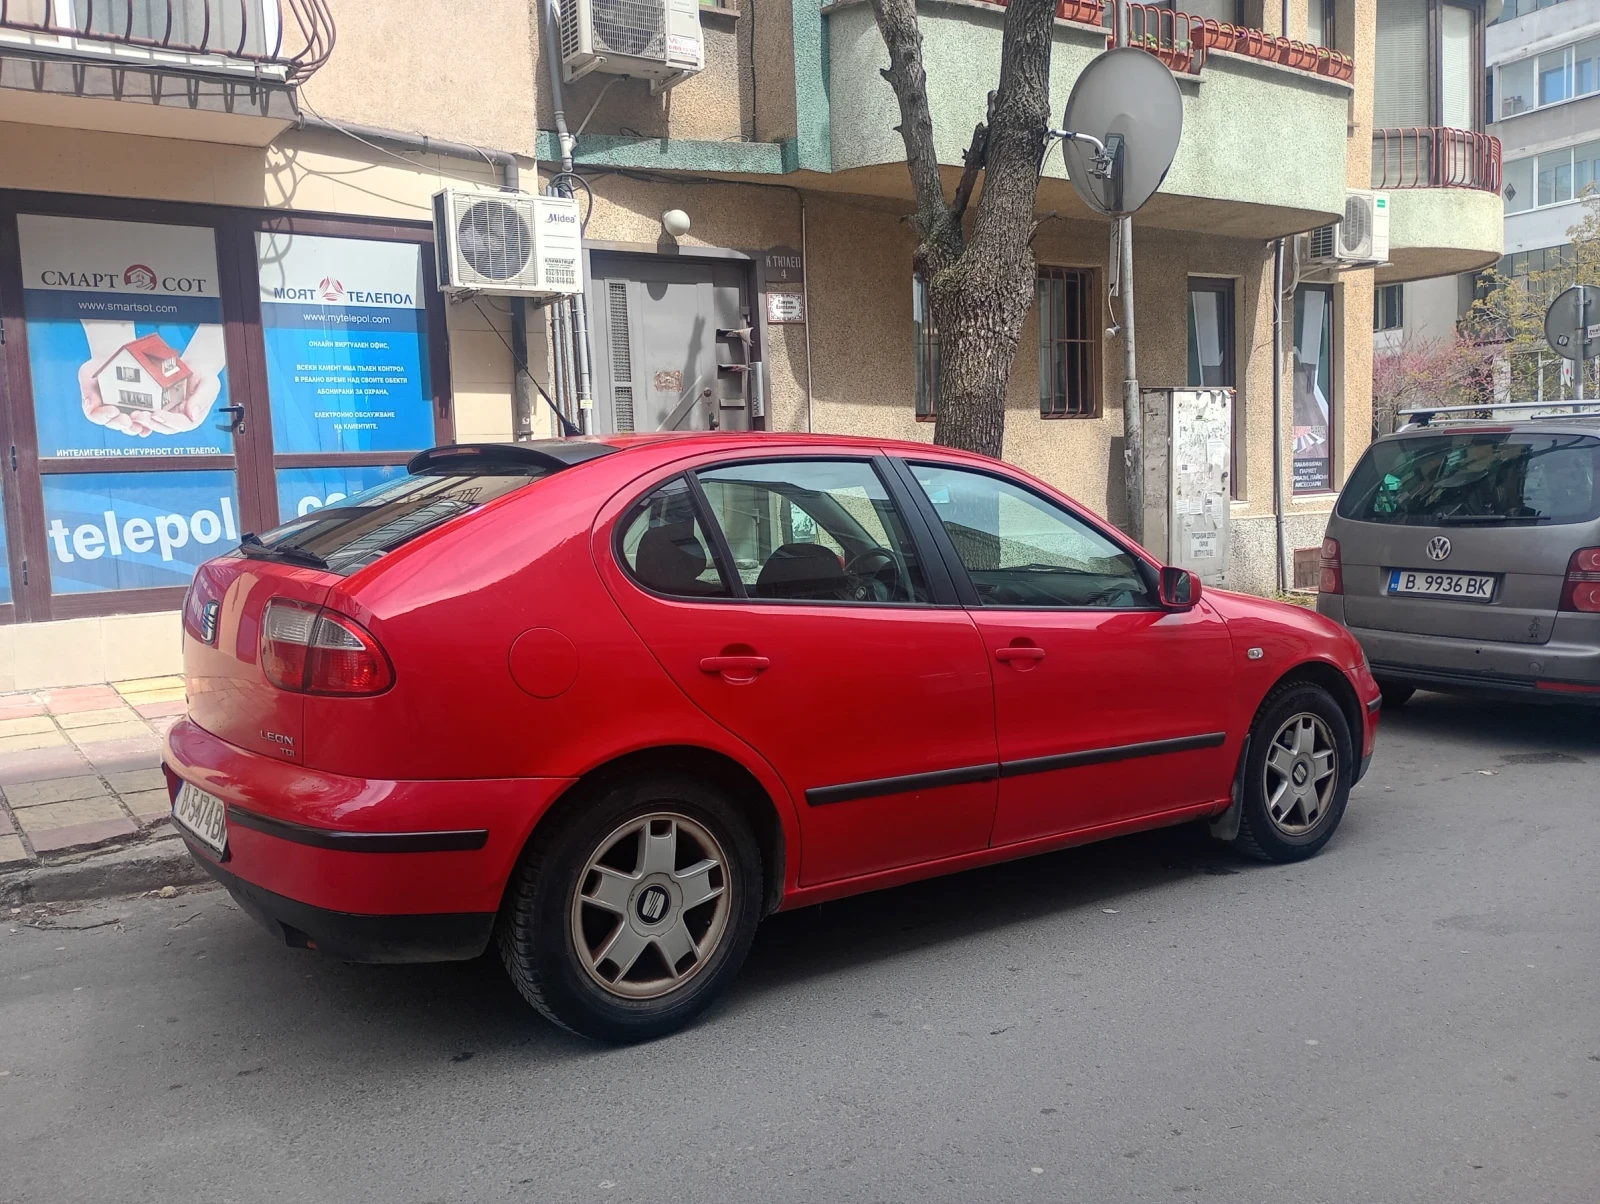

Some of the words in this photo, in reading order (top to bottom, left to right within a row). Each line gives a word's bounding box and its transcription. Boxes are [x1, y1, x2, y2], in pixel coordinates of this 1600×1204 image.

[545, 213, 575, 223] Midea
[780, 268, 787, 279] 4
[41, 270, 119, 289] СМАРТ
[162, 277, 207, 293] СОТ
[273, 287, 316, 300] МОЯТ
[347, 291, 413, 305] ТЕЛЕПОЛ
[78, 302, 178, 313] www.smartsot.com
[303, 313, 391, 325] www.mytelepol.com
[56, 449, 122, 457] ИНТЕЛИГЕНТНА
[123, 448, 172, 456] СИГУРНОСТ
[173, 447, 184, 455] ОТ
[185, 446, 221, 454] ТЕЛЕПОЛ
[48, 496, 237, 563] telepol
[1405, 574, 1416, 590] B
[1425, 575, 1463, 593] 9936
[1465, 577, 1490, 595] BK
[260, 729, 294, 746] LEON
[280, 747, 295, 757] TDI
